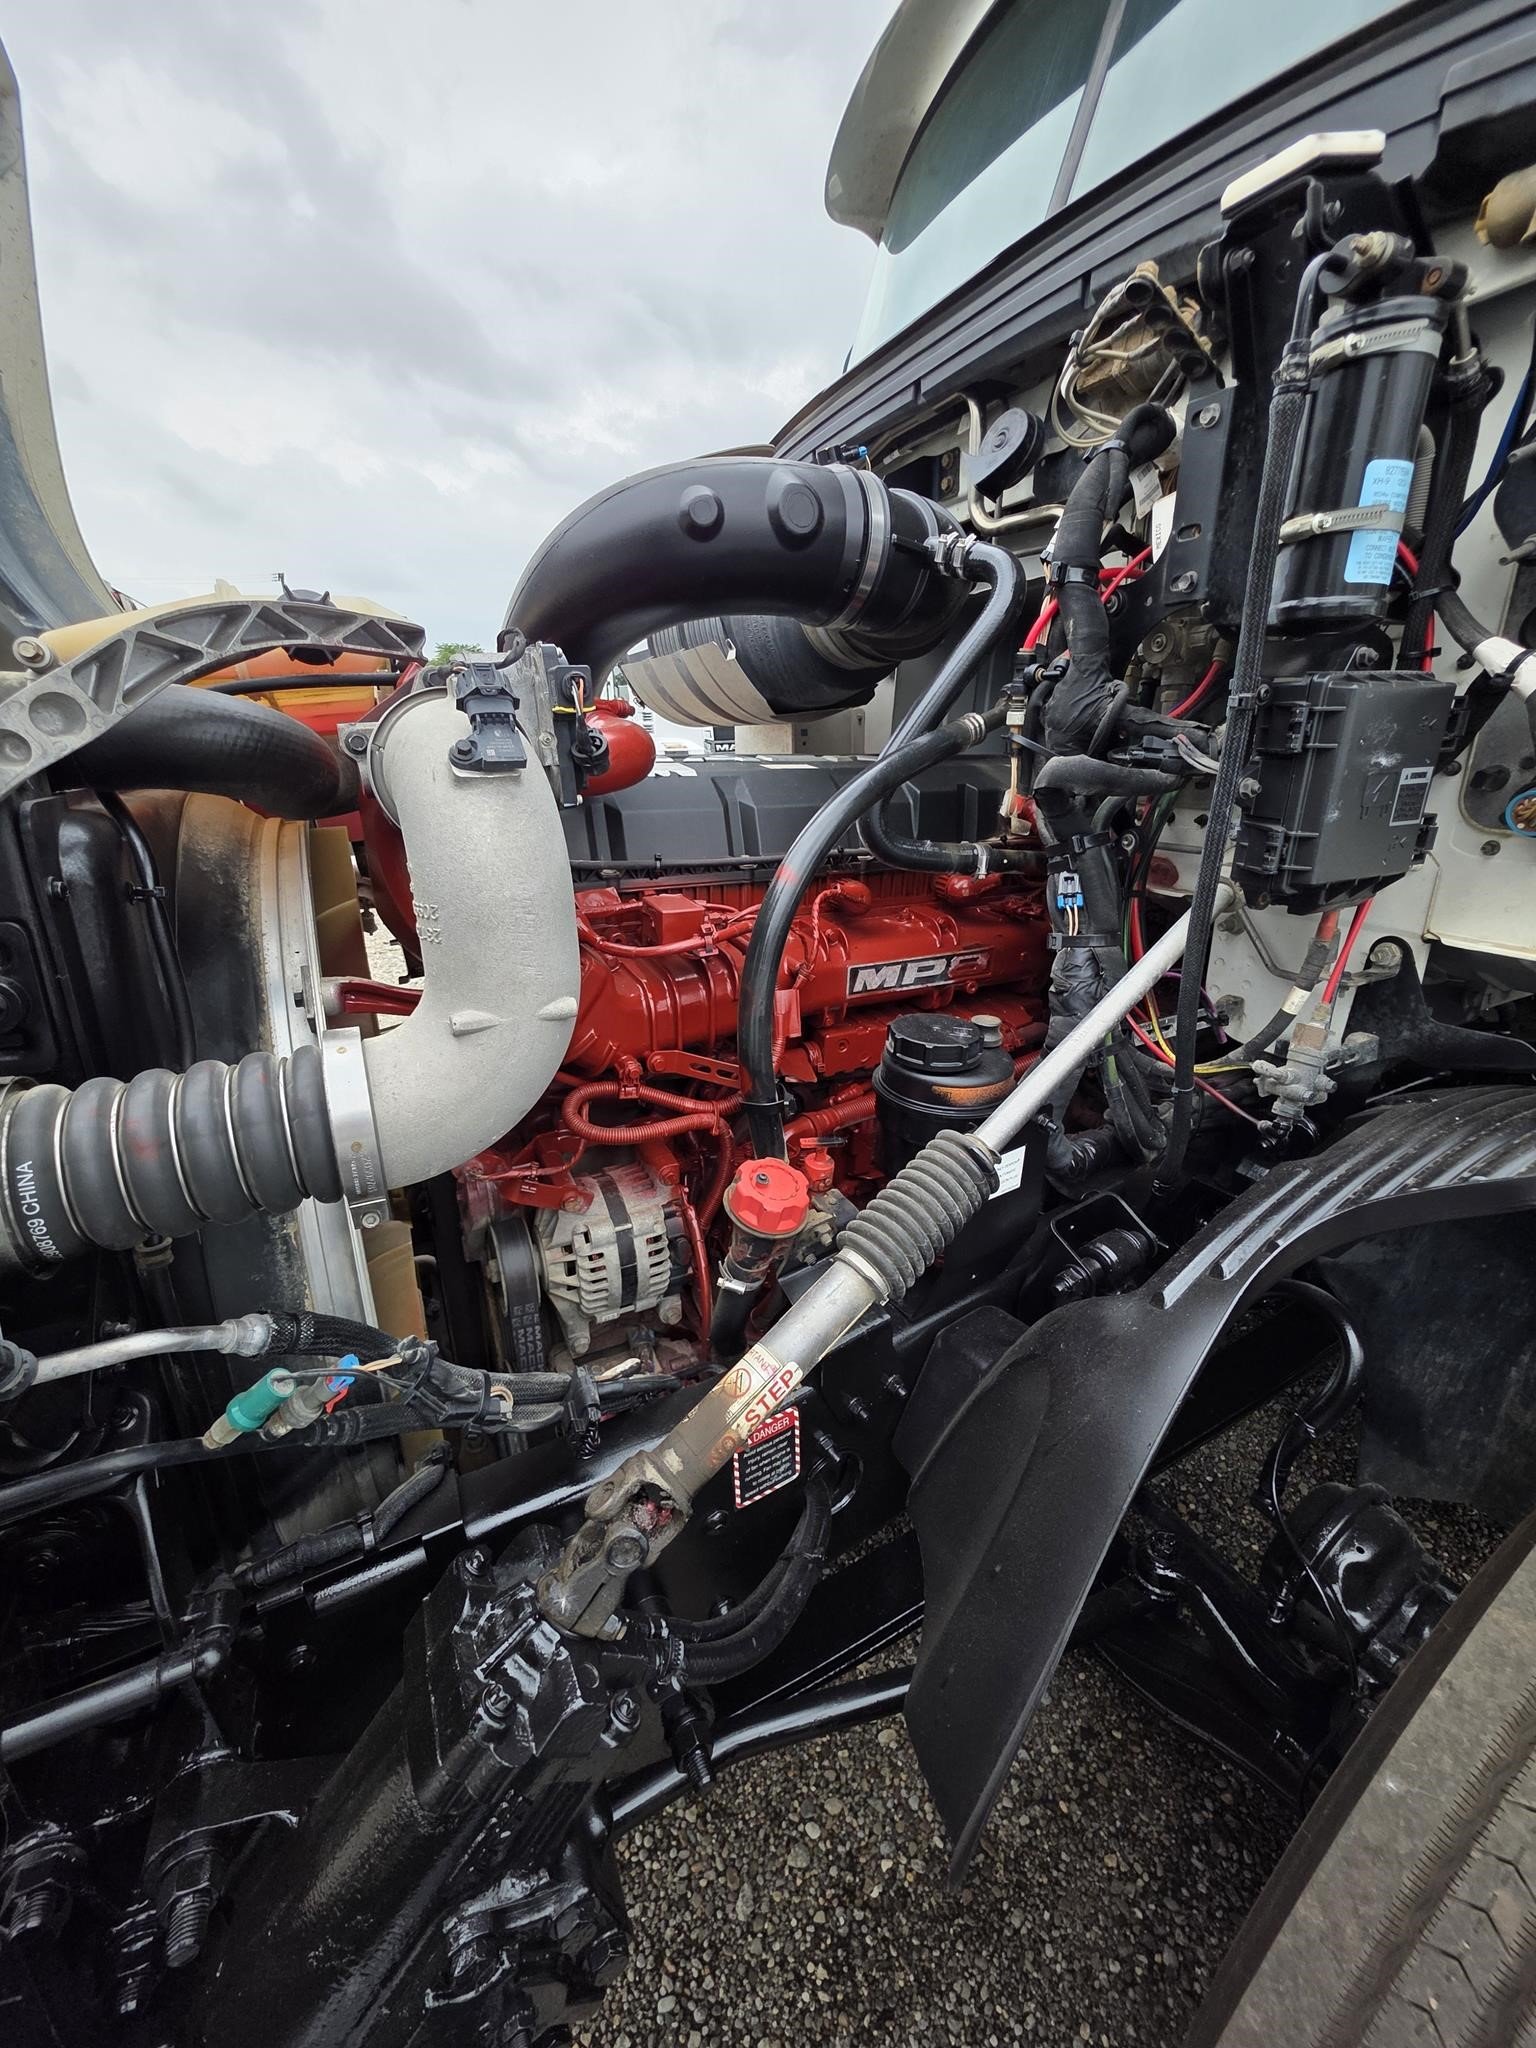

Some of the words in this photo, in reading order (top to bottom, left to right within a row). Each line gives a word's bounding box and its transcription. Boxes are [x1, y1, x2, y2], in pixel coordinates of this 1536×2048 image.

[16, 1161, 40, 1215] CHINA
[745, 1369, 794, 1424] STEP
[753, 1417, 790, 1442] DANGER
[773, 1430, 792, 1444] personal
[771, 1450, 786, 1460] engine
